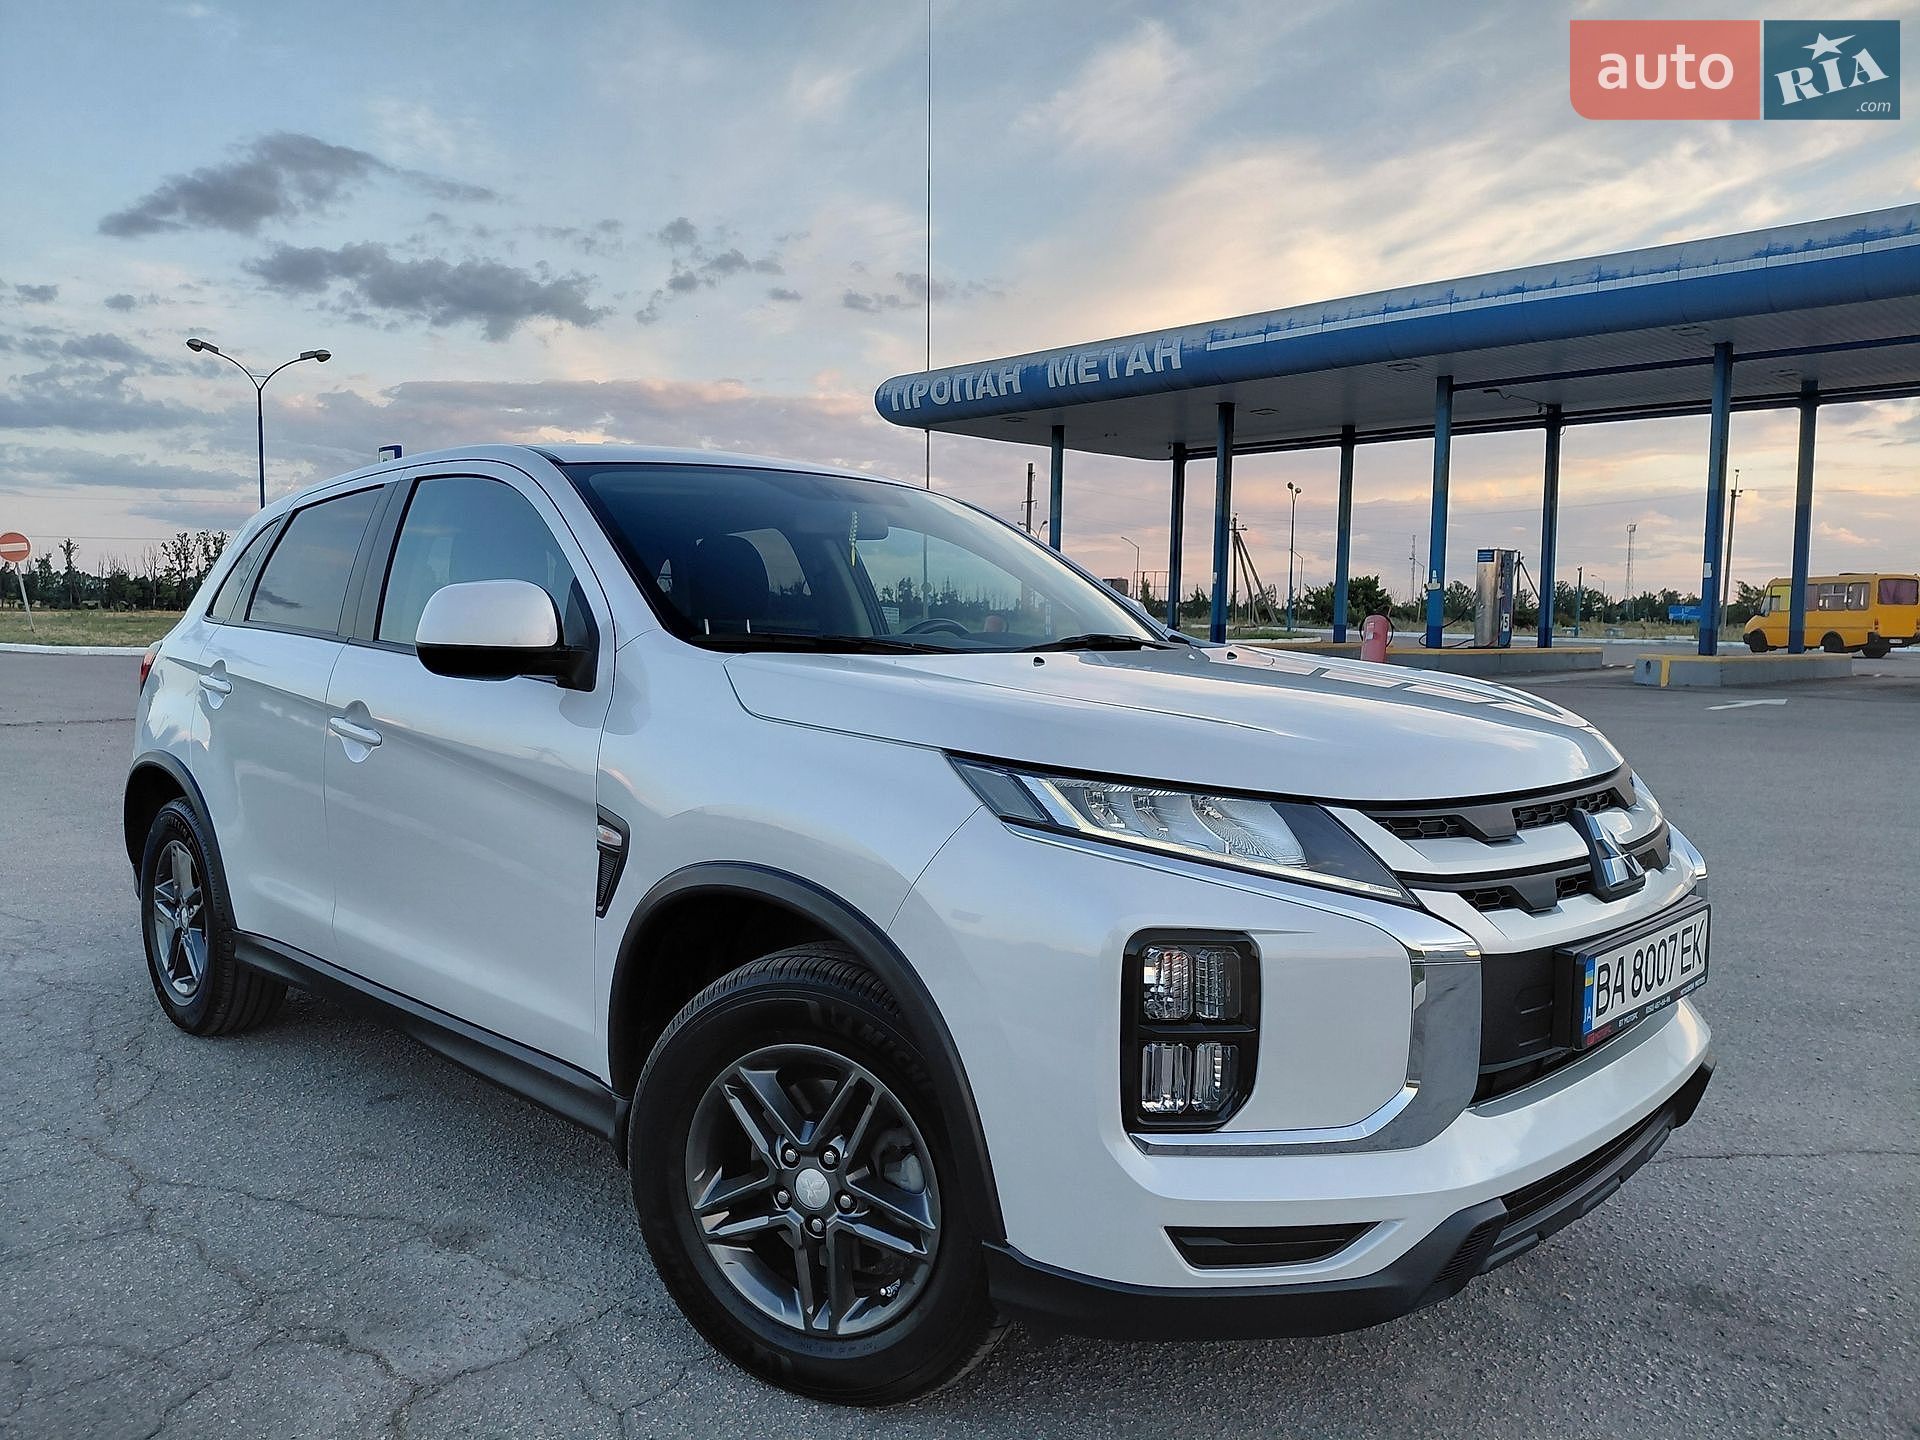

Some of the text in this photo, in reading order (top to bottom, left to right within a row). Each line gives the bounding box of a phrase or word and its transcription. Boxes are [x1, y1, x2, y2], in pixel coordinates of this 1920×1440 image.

[890, 335, 1184, 412] ПРОПАН МЕТАН
[1595, 919, 1705, 1018] BA 8007 EK
